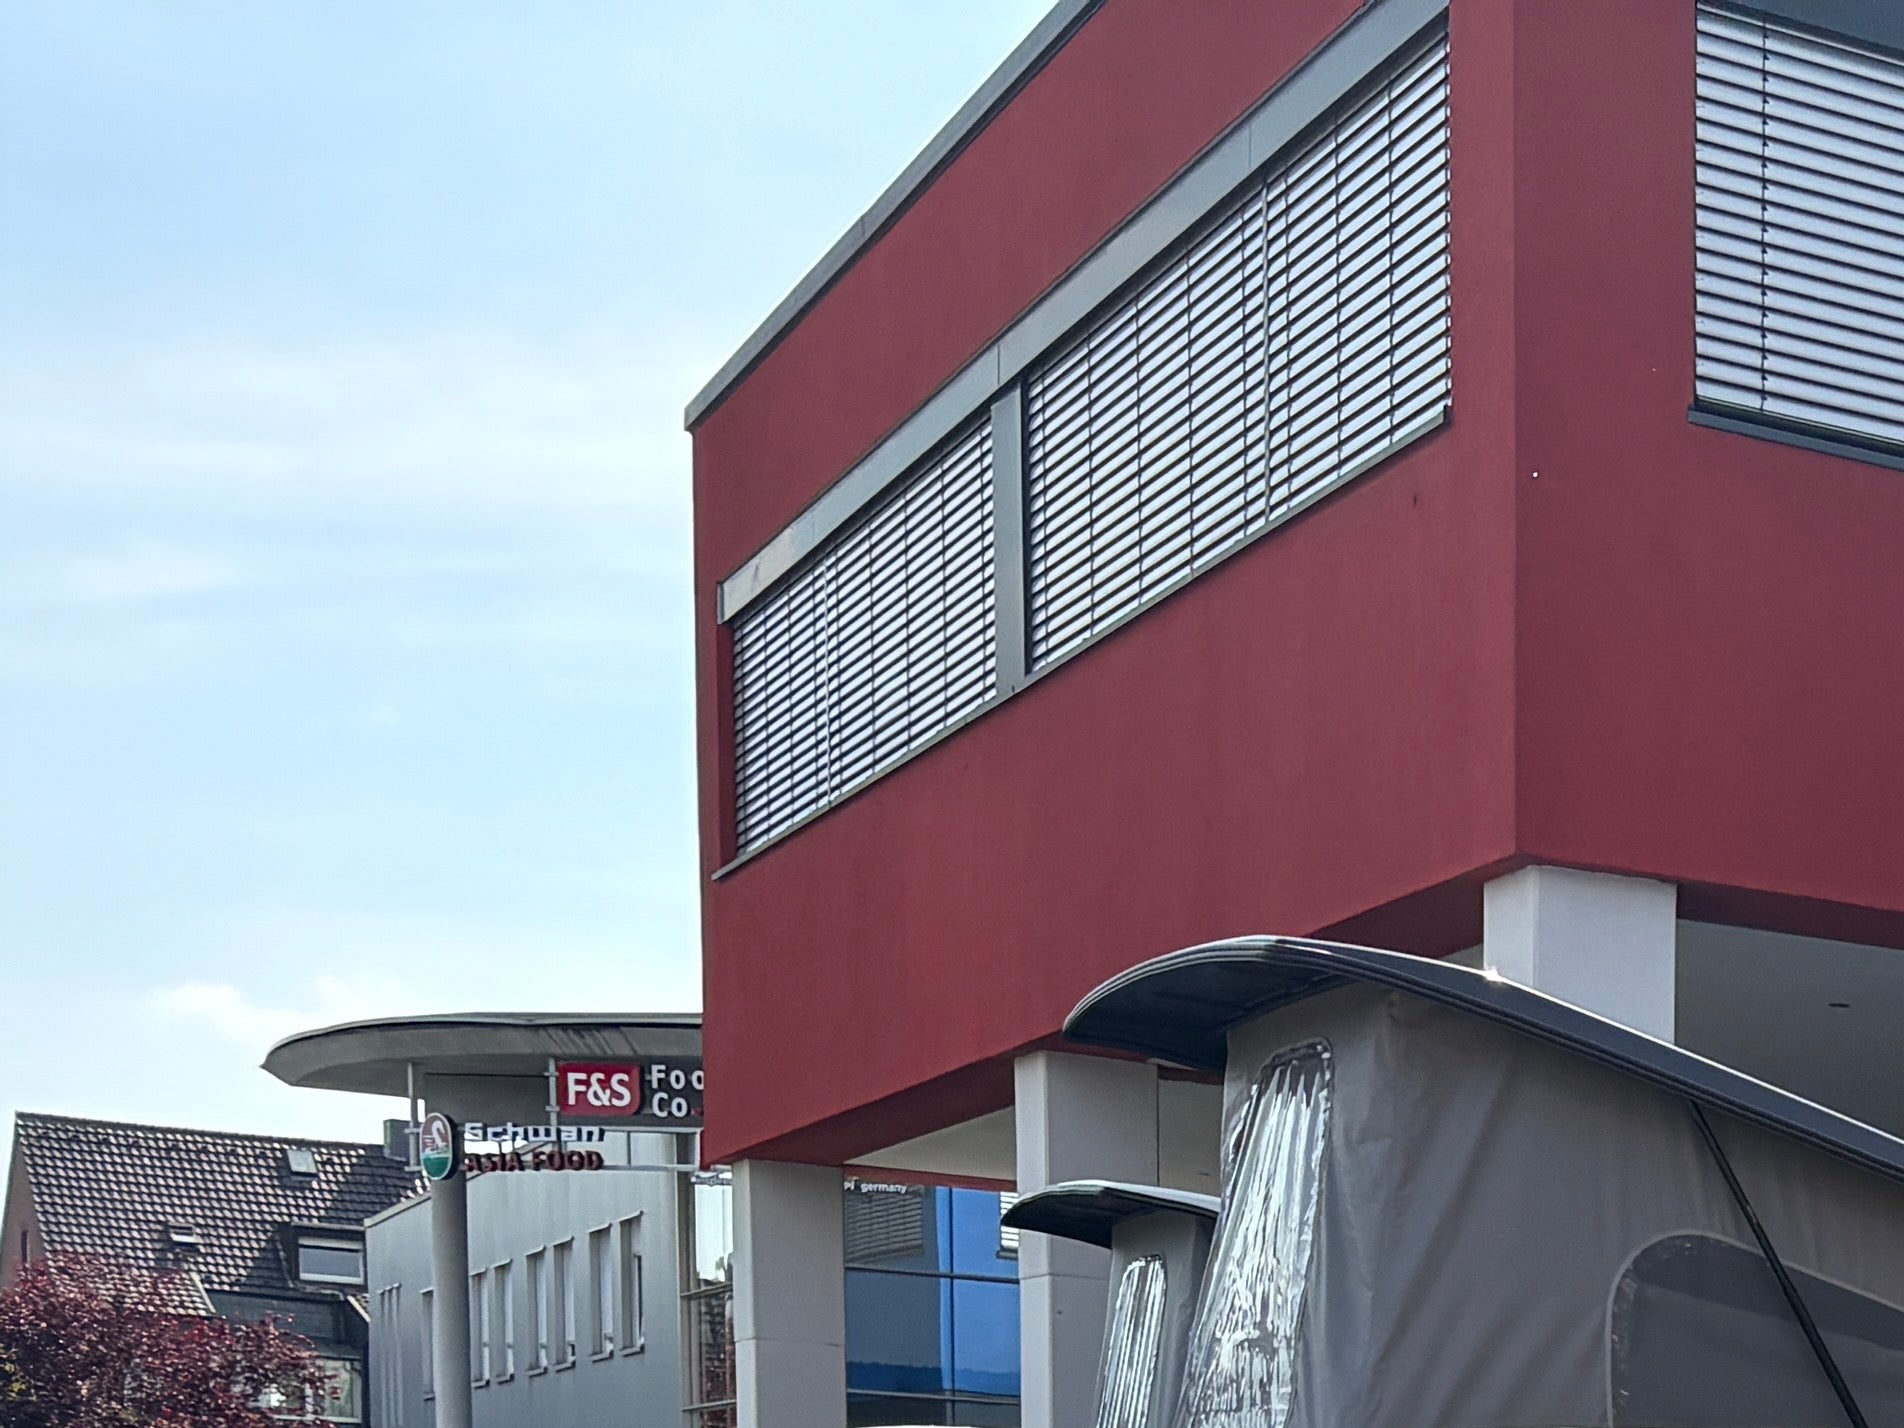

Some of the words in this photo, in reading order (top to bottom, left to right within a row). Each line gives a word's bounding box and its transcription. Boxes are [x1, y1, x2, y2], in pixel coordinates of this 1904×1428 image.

[567, 1072, 632, 1107] F&S
[464, 1122, 602, 1143] Schwan
[464, 1152, 525, 1172] ASIA
[531, 1150, 604, 1172] FOOD
